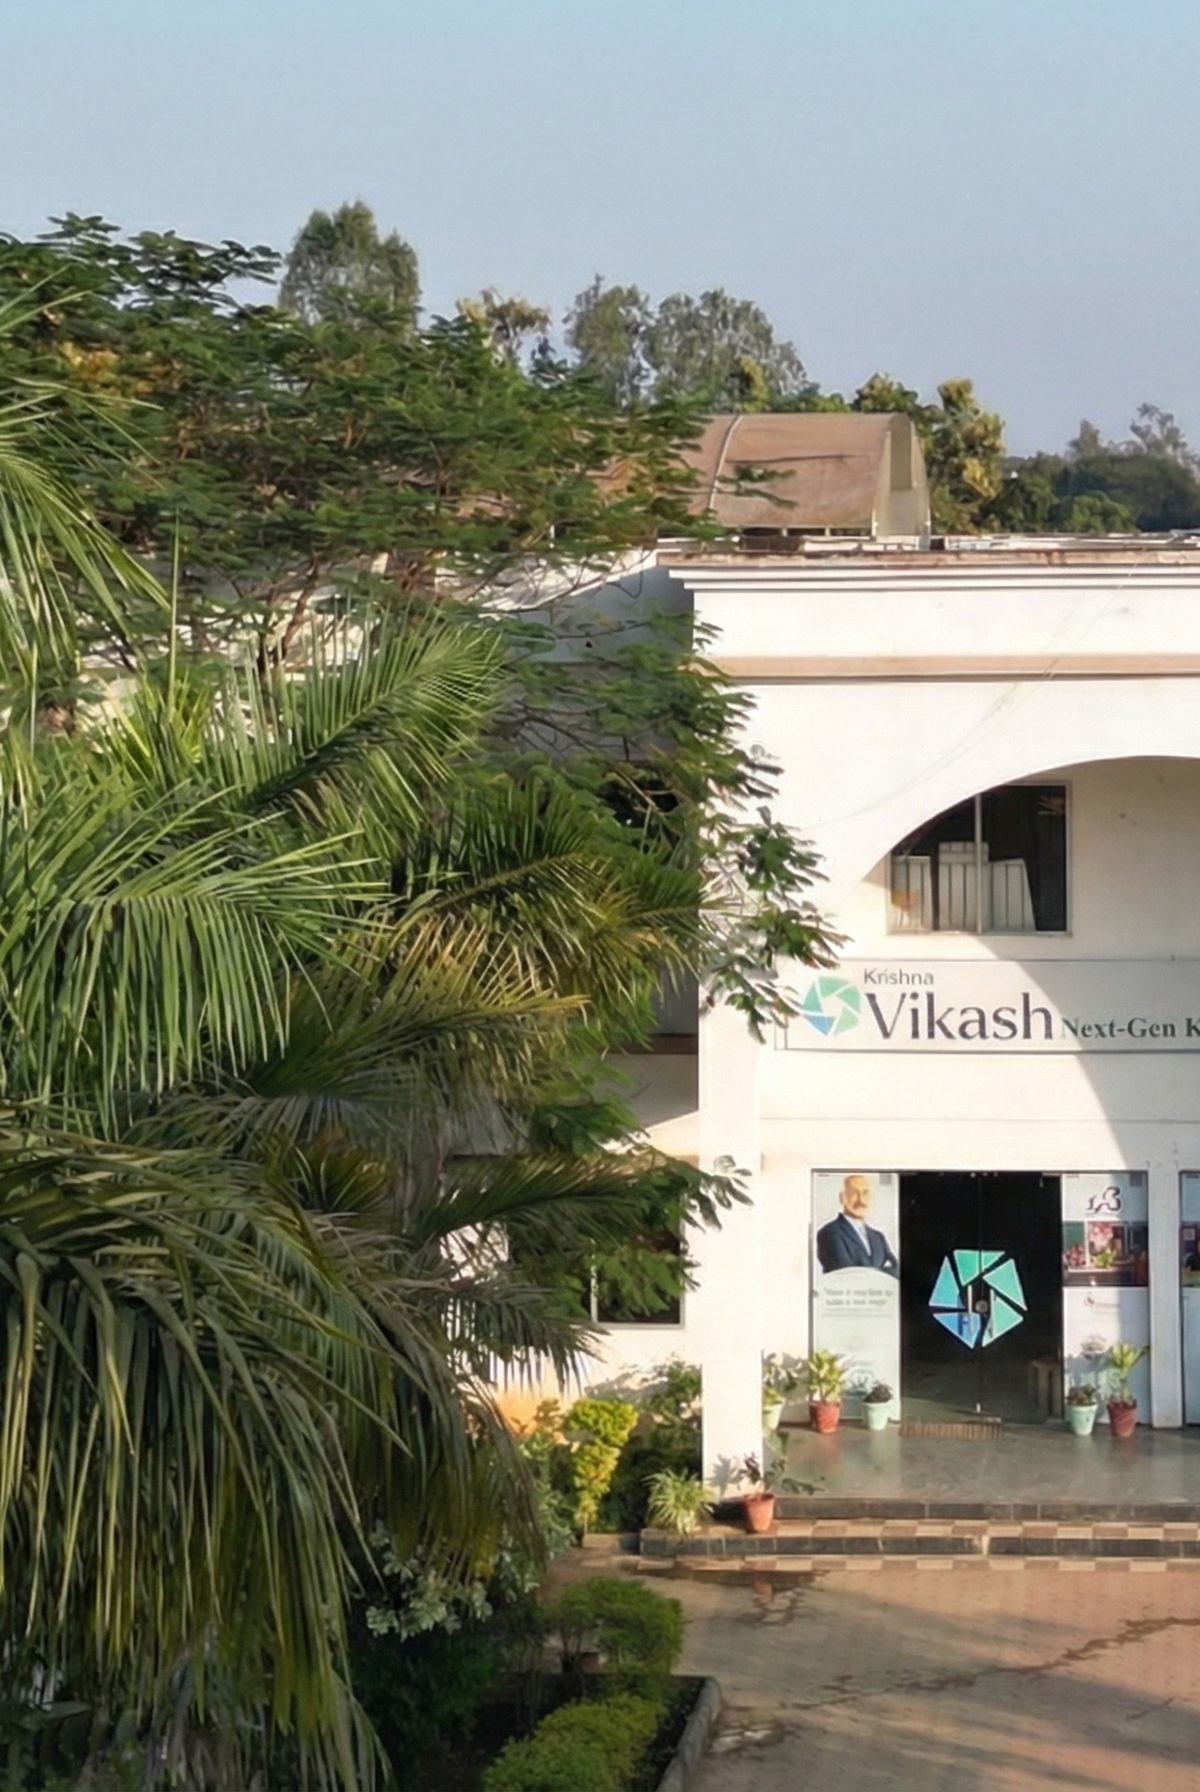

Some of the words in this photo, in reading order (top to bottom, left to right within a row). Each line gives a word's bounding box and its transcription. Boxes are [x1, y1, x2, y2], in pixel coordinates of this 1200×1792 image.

[863, 967, 934, 985] Krishna
[865, 992, 1053, 1039] Vikash
[1061, 1017, 1176, 1038] Next-Gen
